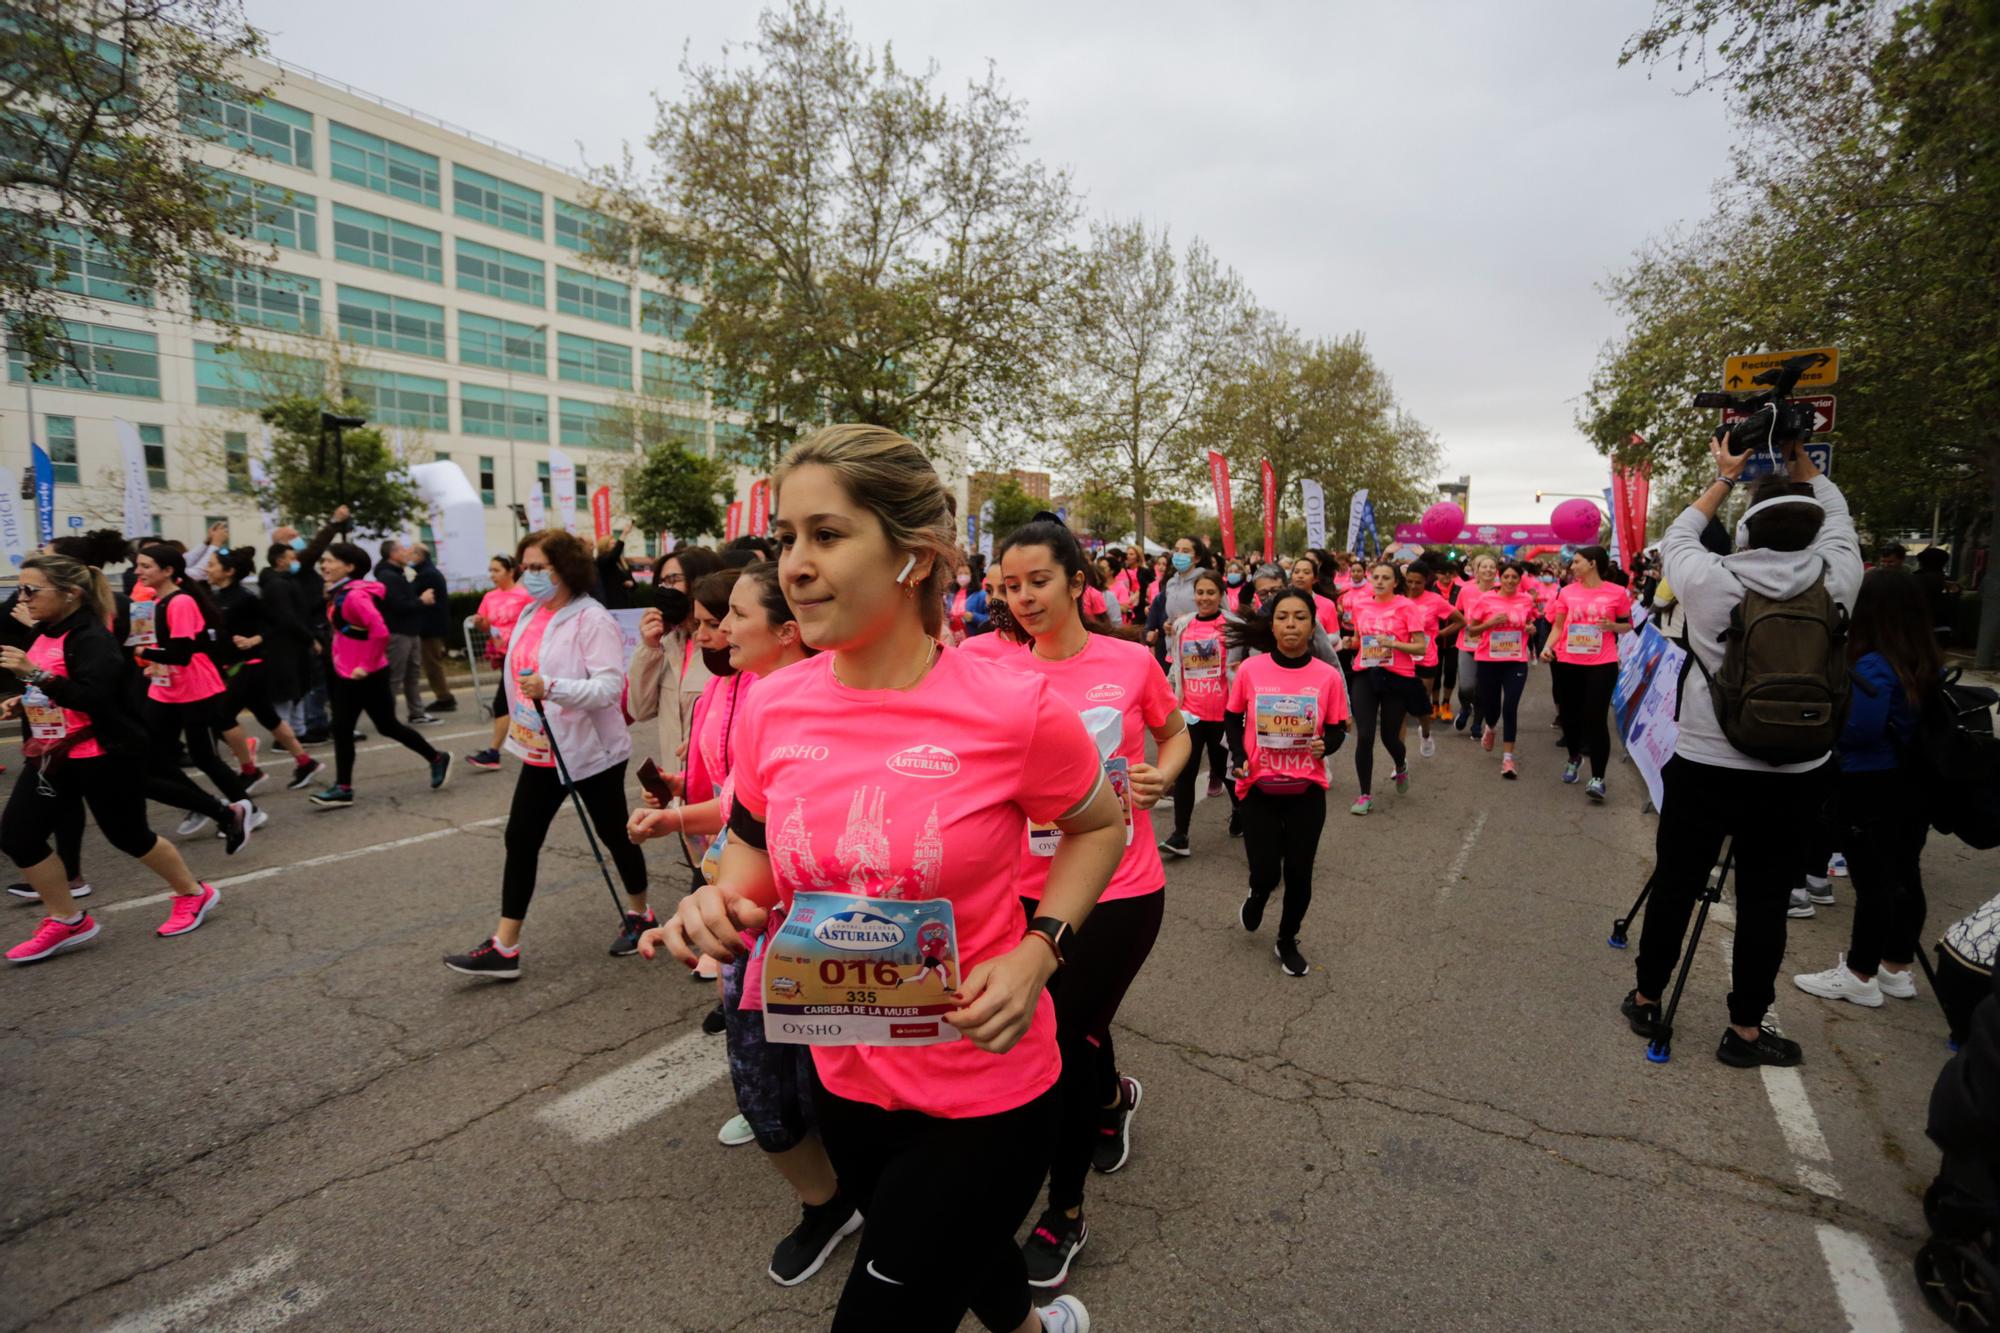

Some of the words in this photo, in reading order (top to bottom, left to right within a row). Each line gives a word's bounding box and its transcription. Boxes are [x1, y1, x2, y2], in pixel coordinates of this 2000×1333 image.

[1274, 715, 1299, 726] 016
[1259, 753, 1315, 770] SUMA
[819, 925, 899, 943] ASTURIANA
[819, 959, 900, 986] 016
[846, 991, 877, 1004] 335
[803, 1005, 850, 1014] CARRERA
[852, 1006, 866, 1014] DE
[868, 1007, 882, 1016] LA
[884, 1007, 920, 1016] MUJER
[783, 1022, 842, 1036] OYSHO
